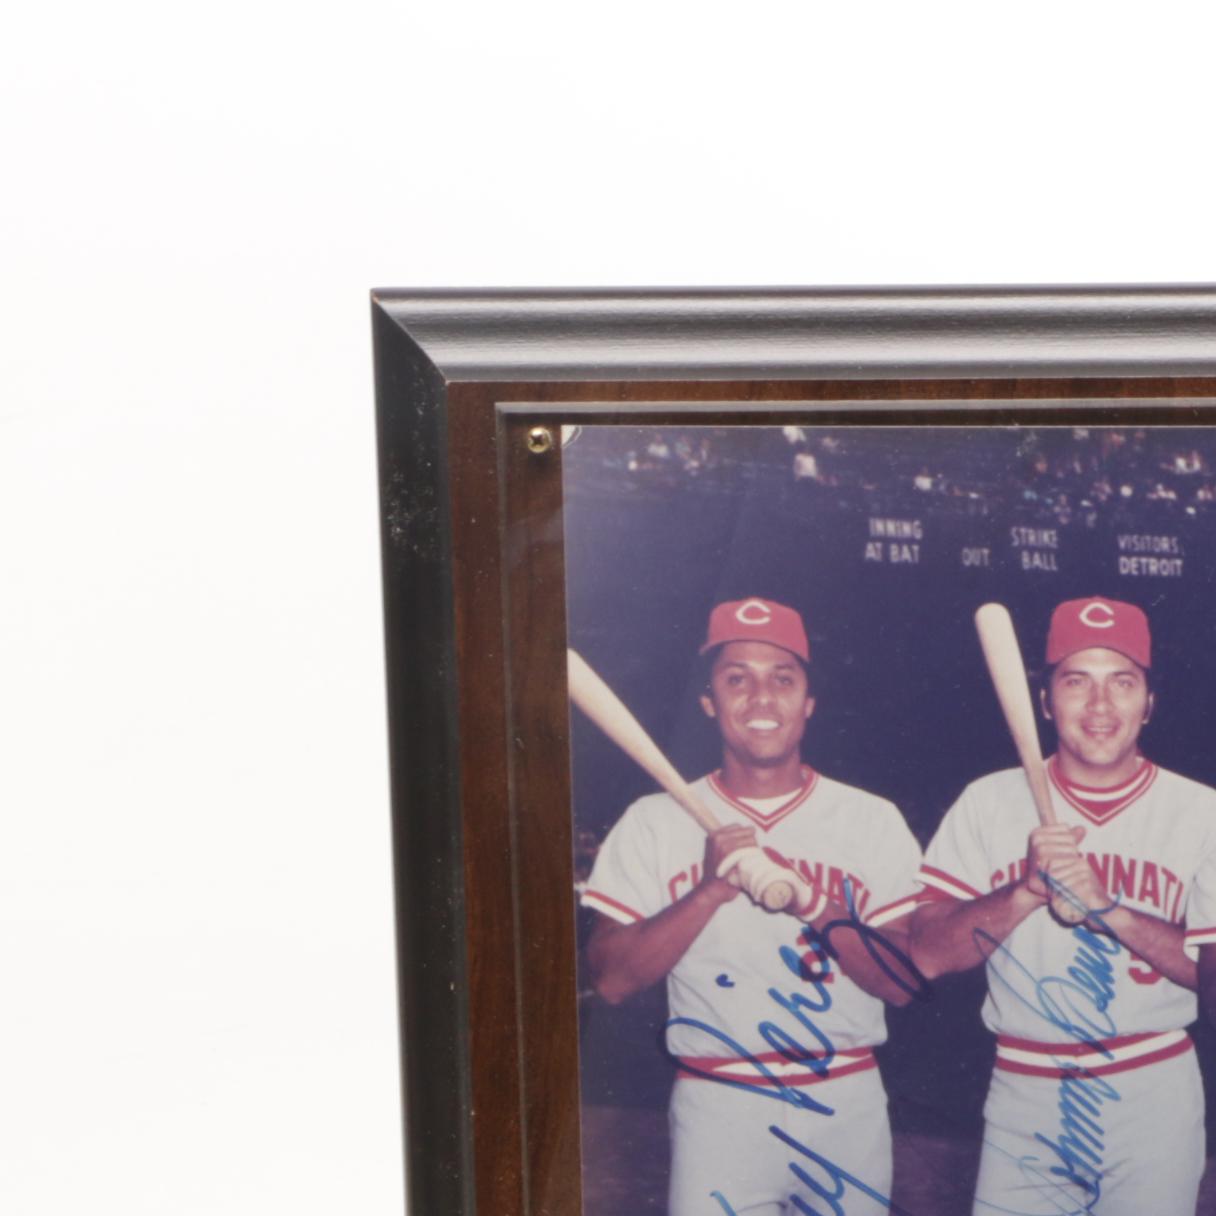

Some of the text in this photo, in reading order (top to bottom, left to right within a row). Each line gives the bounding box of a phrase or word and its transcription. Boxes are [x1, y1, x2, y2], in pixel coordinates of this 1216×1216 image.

[869, 518, 922, 539] INNING
[1010, 527, 1058, 548] STRIKE
[865, 542, 919, 563] AT BAT
[962, 547, 990, 566] OUT
[1022, 550, 1058, 571] BALL
[1119, 556, 1183, 577] DETROIT
[735, 601, 770, 625] C
[1079, 602, 1115, 628] C
